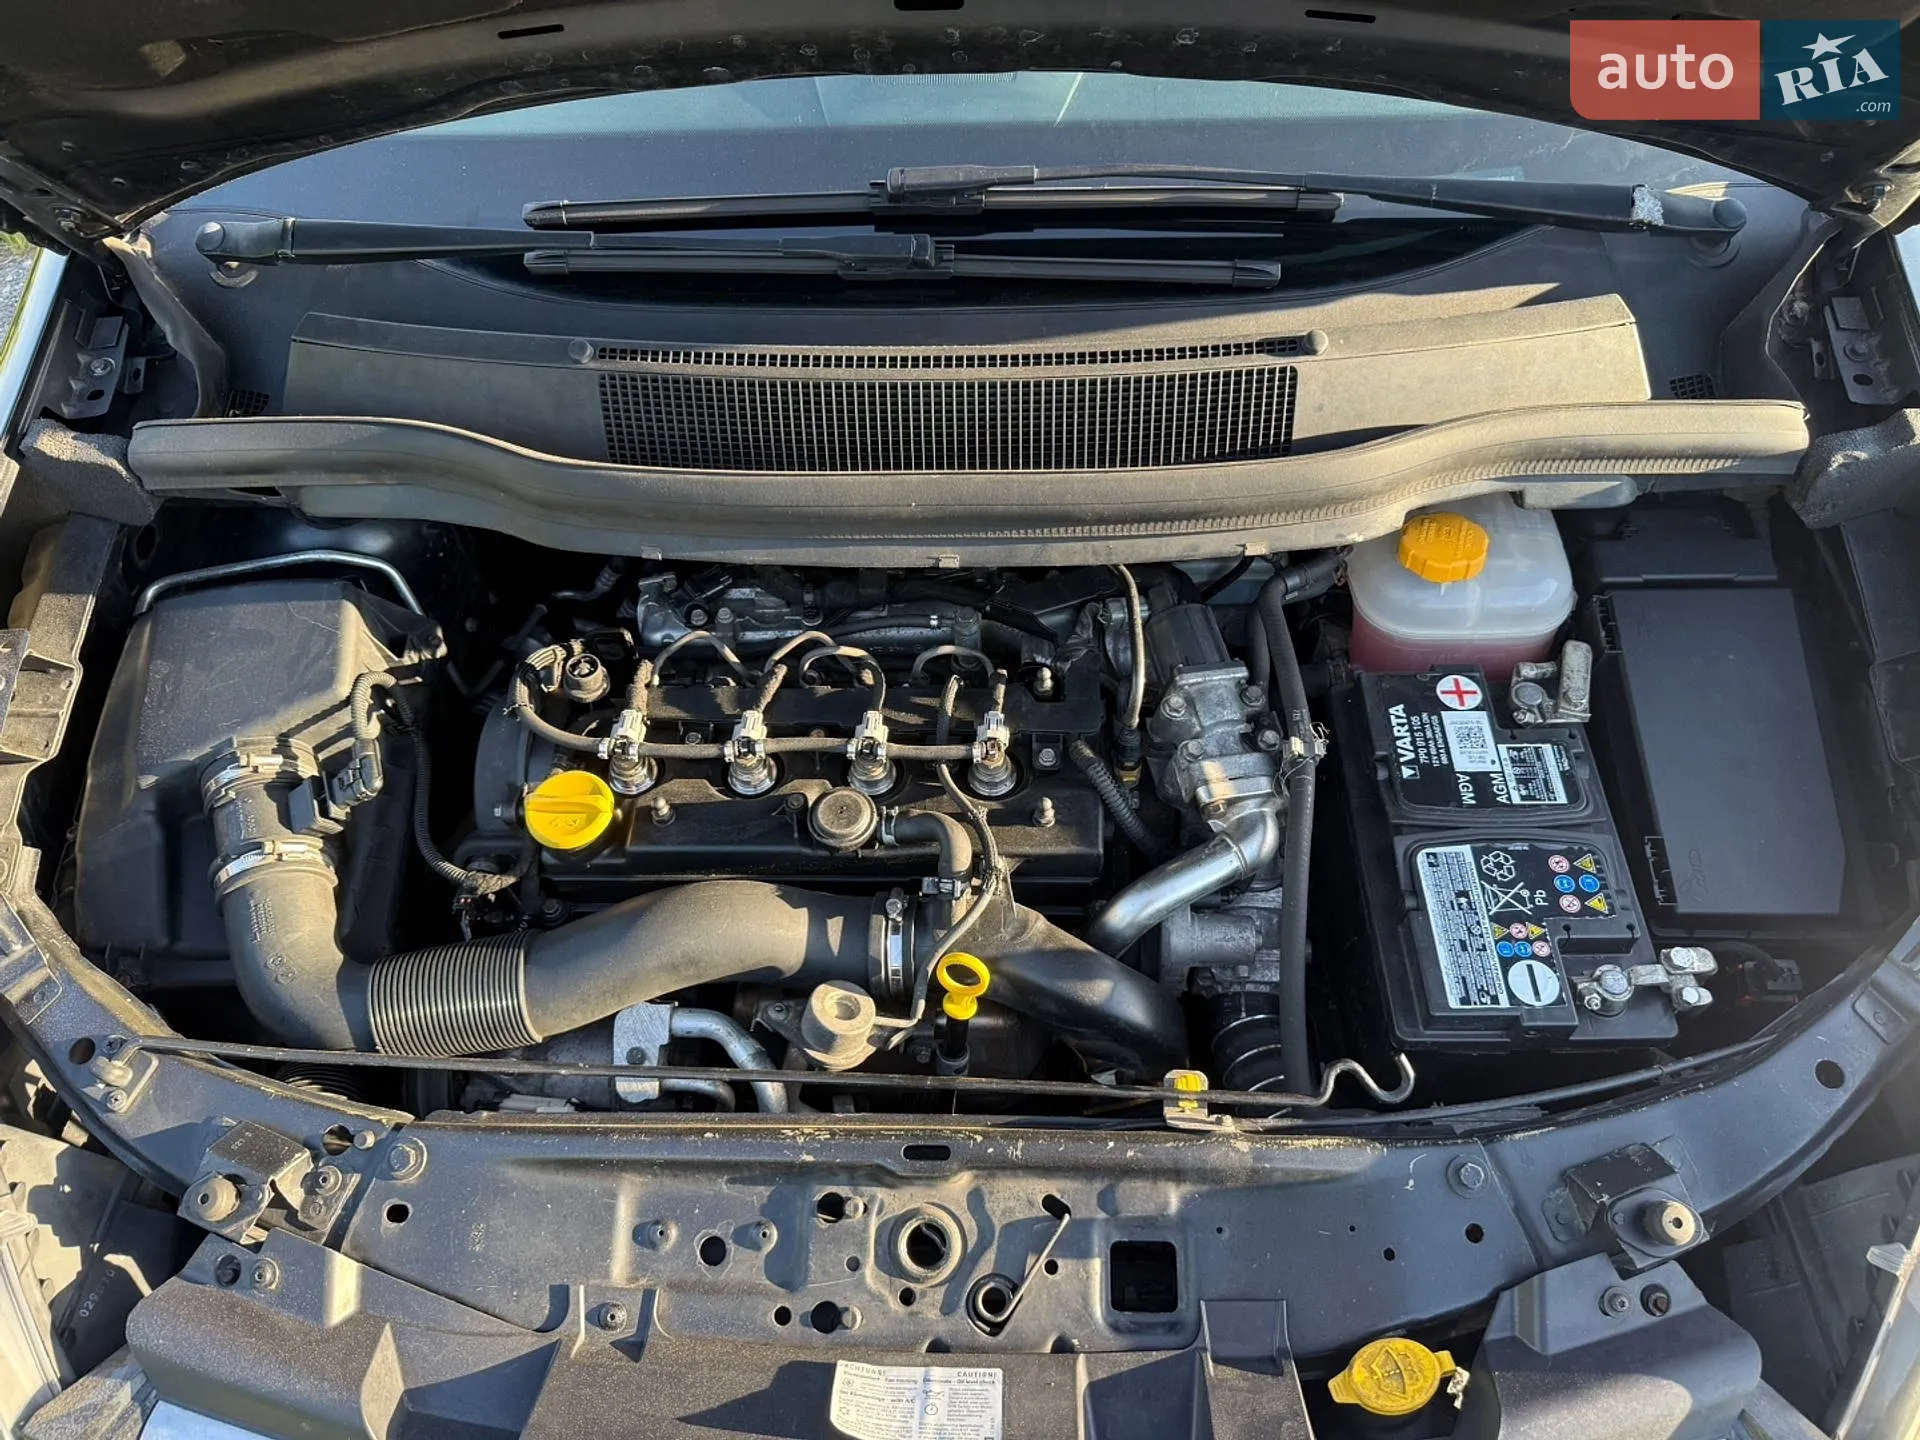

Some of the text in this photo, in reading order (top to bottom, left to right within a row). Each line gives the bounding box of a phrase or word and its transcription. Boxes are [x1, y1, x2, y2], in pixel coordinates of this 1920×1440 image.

[1388, 703, 1416, 762] VARTA
[1455, 773, 1477, 804] AGM
[1489, 773, 1511, 804] AGM
[1534, 889, 1549, 906] Pb
